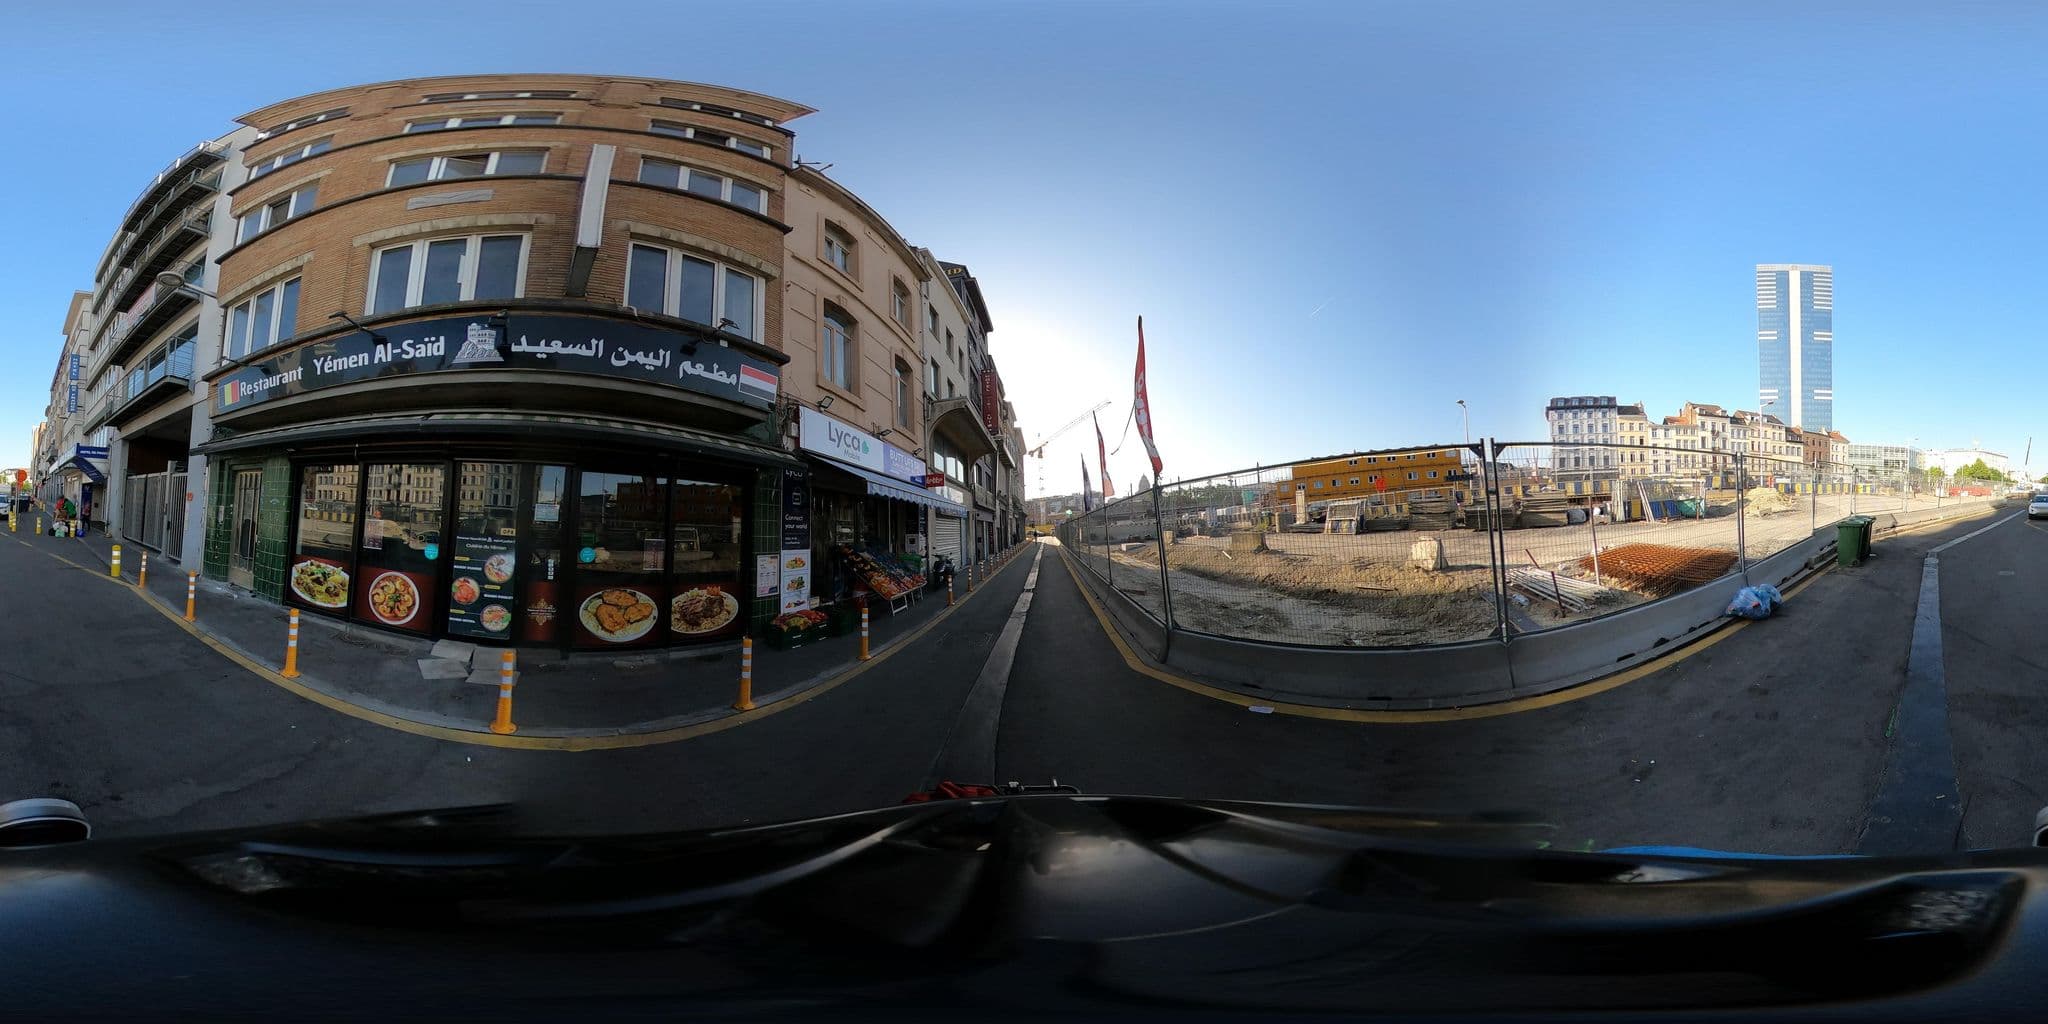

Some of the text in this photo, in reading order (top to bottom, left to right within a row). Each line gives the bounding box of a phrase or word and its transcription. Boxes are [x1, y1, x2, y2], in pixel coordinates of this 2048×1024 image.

[240, 335, 445, 397] Restaurant Yémen Al-Saïd
[511, 334, 738, 386] مطعم اليمن السعيد
[828, 421, 861, 451] Lyca
